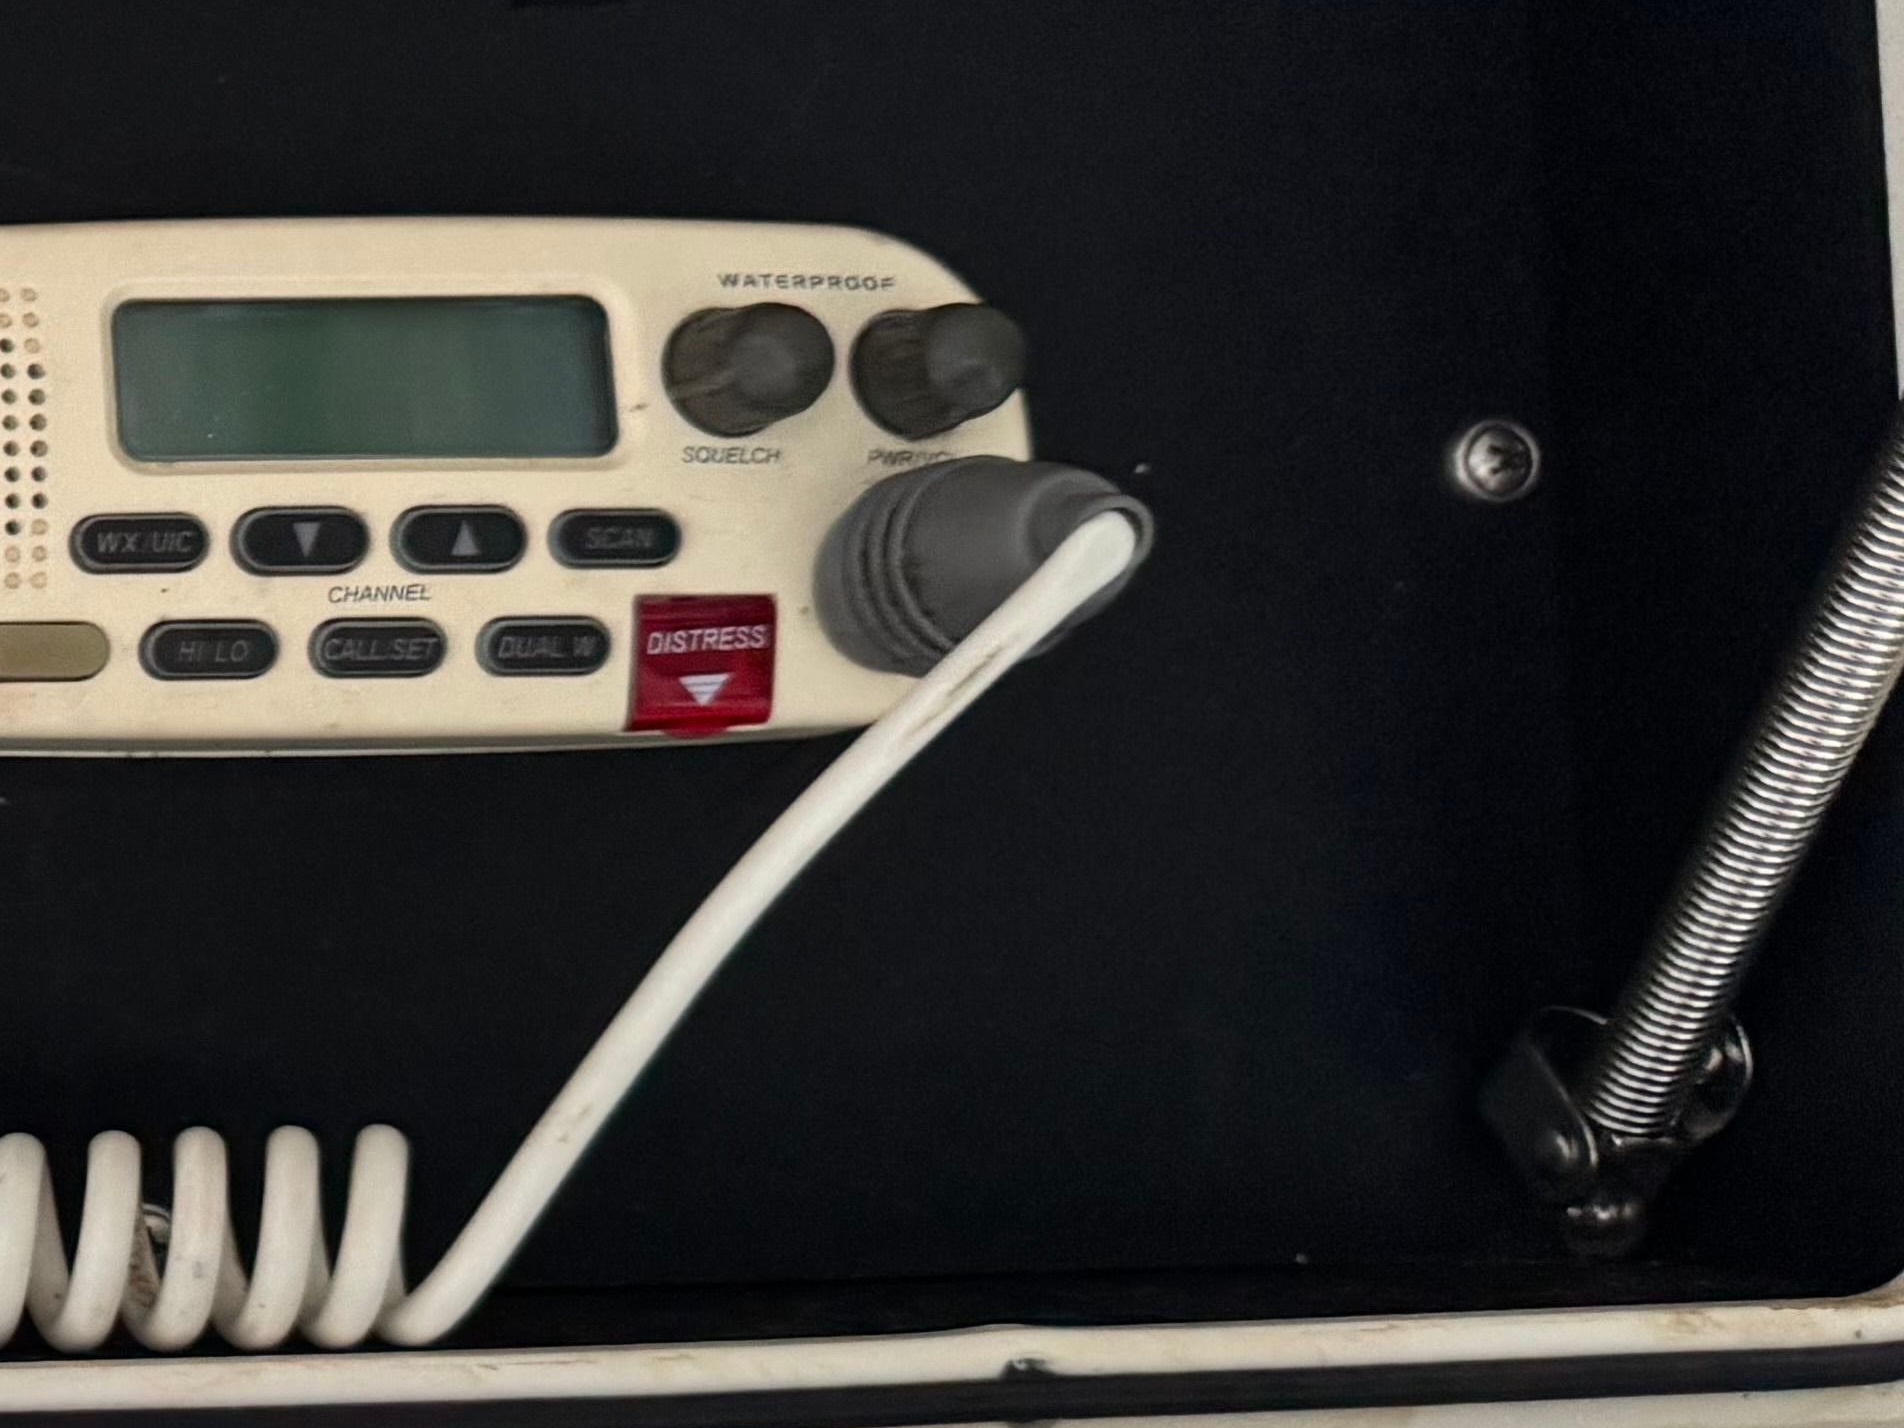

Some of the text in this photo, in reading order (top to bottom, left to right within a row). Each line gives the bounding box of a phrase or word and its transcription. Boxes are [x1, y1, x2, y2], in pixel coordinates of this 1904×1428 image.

[716, 272, 896, 292] WATERPROOF
[680, 445, 783, 465] SQUELCH
[585, 526, 656, 550] SCAN
[327, 583, 433, 604] CHANNEL
[646, 624, 769, 656] DISTRESS
